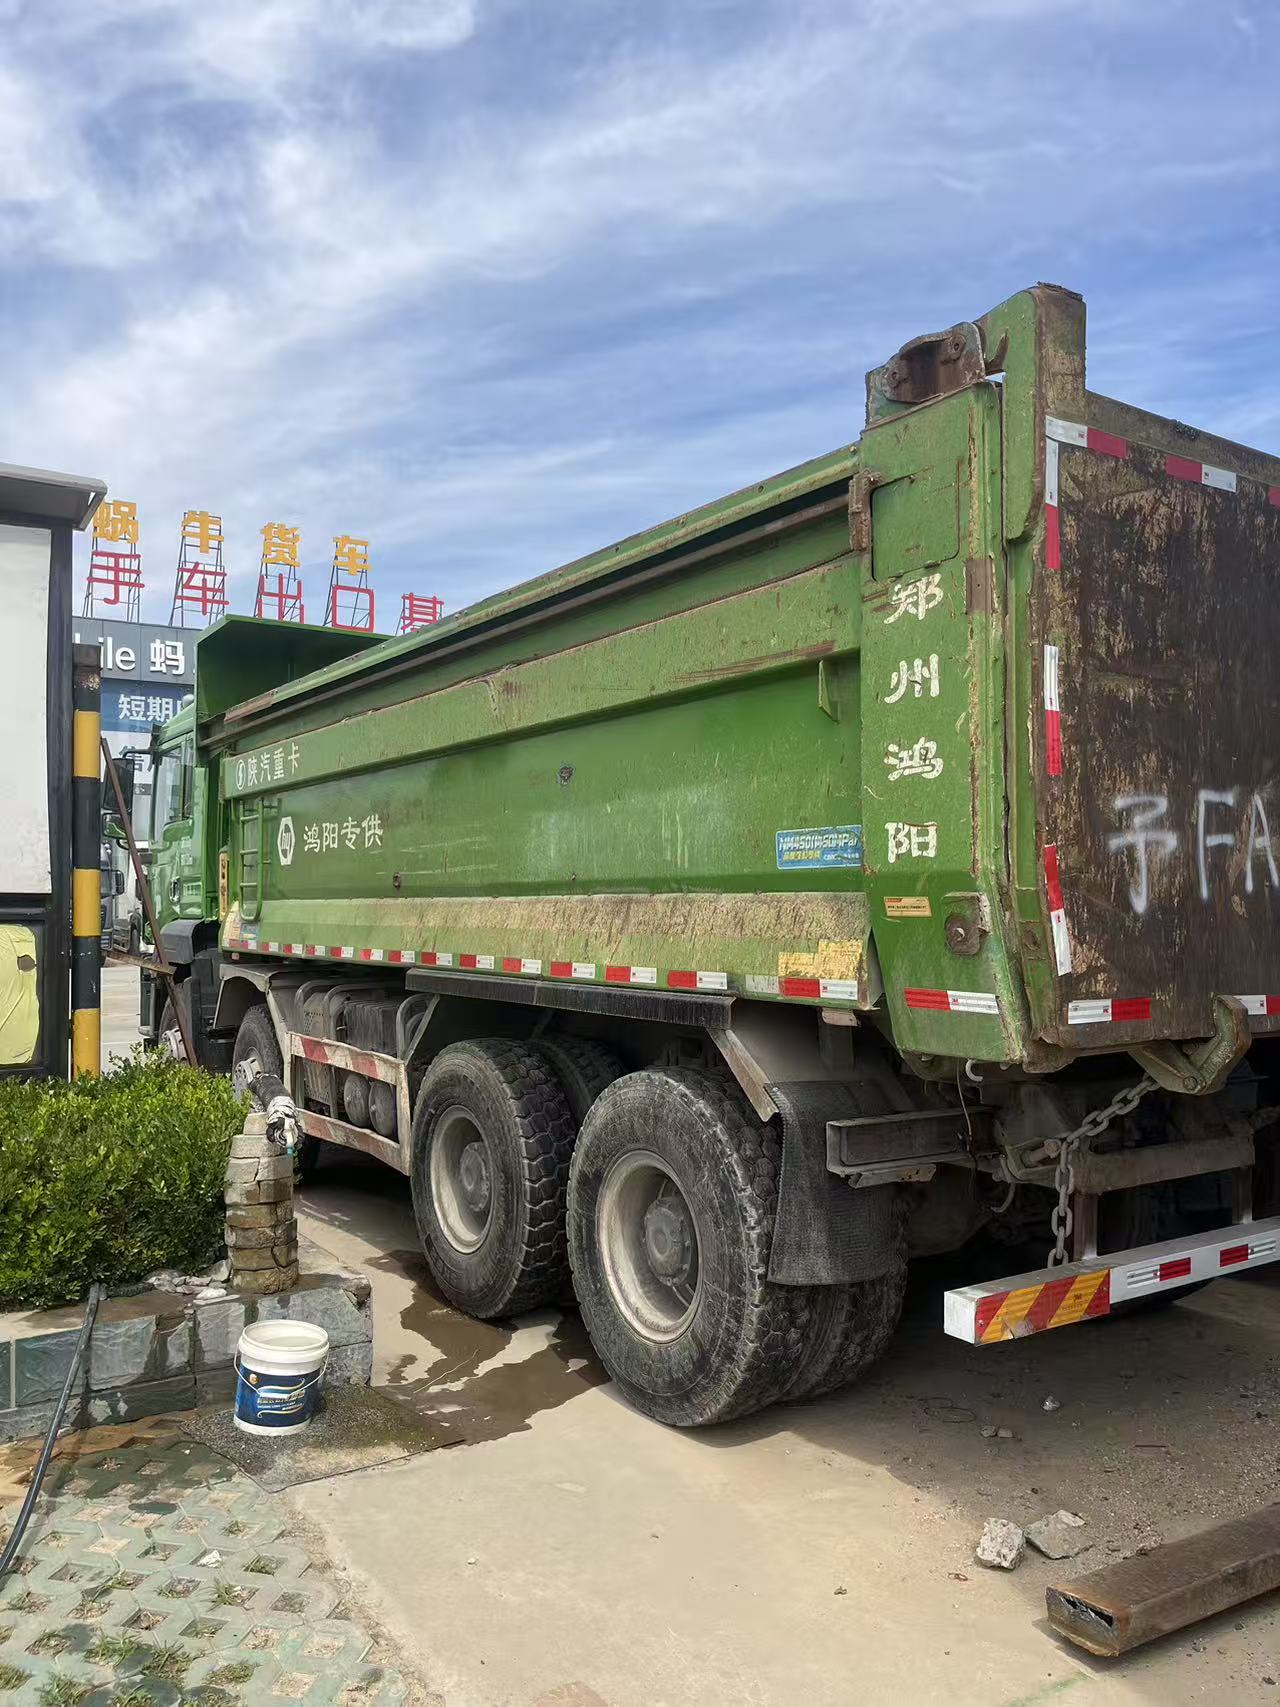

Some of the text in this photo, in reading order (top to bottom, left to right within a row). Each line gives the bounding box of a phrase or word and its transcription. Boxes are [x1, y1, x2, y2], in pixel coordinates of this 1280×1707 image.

[93, 500, 371, 576] 蜗牛货车
[118, 694, 181, 723] 短期
[884, 573, 944, 864] 郑州鸿阳
[248, 742, 300, 787] 陕汽重卡
[303, 813, 384, 854] 鸿阳专供
